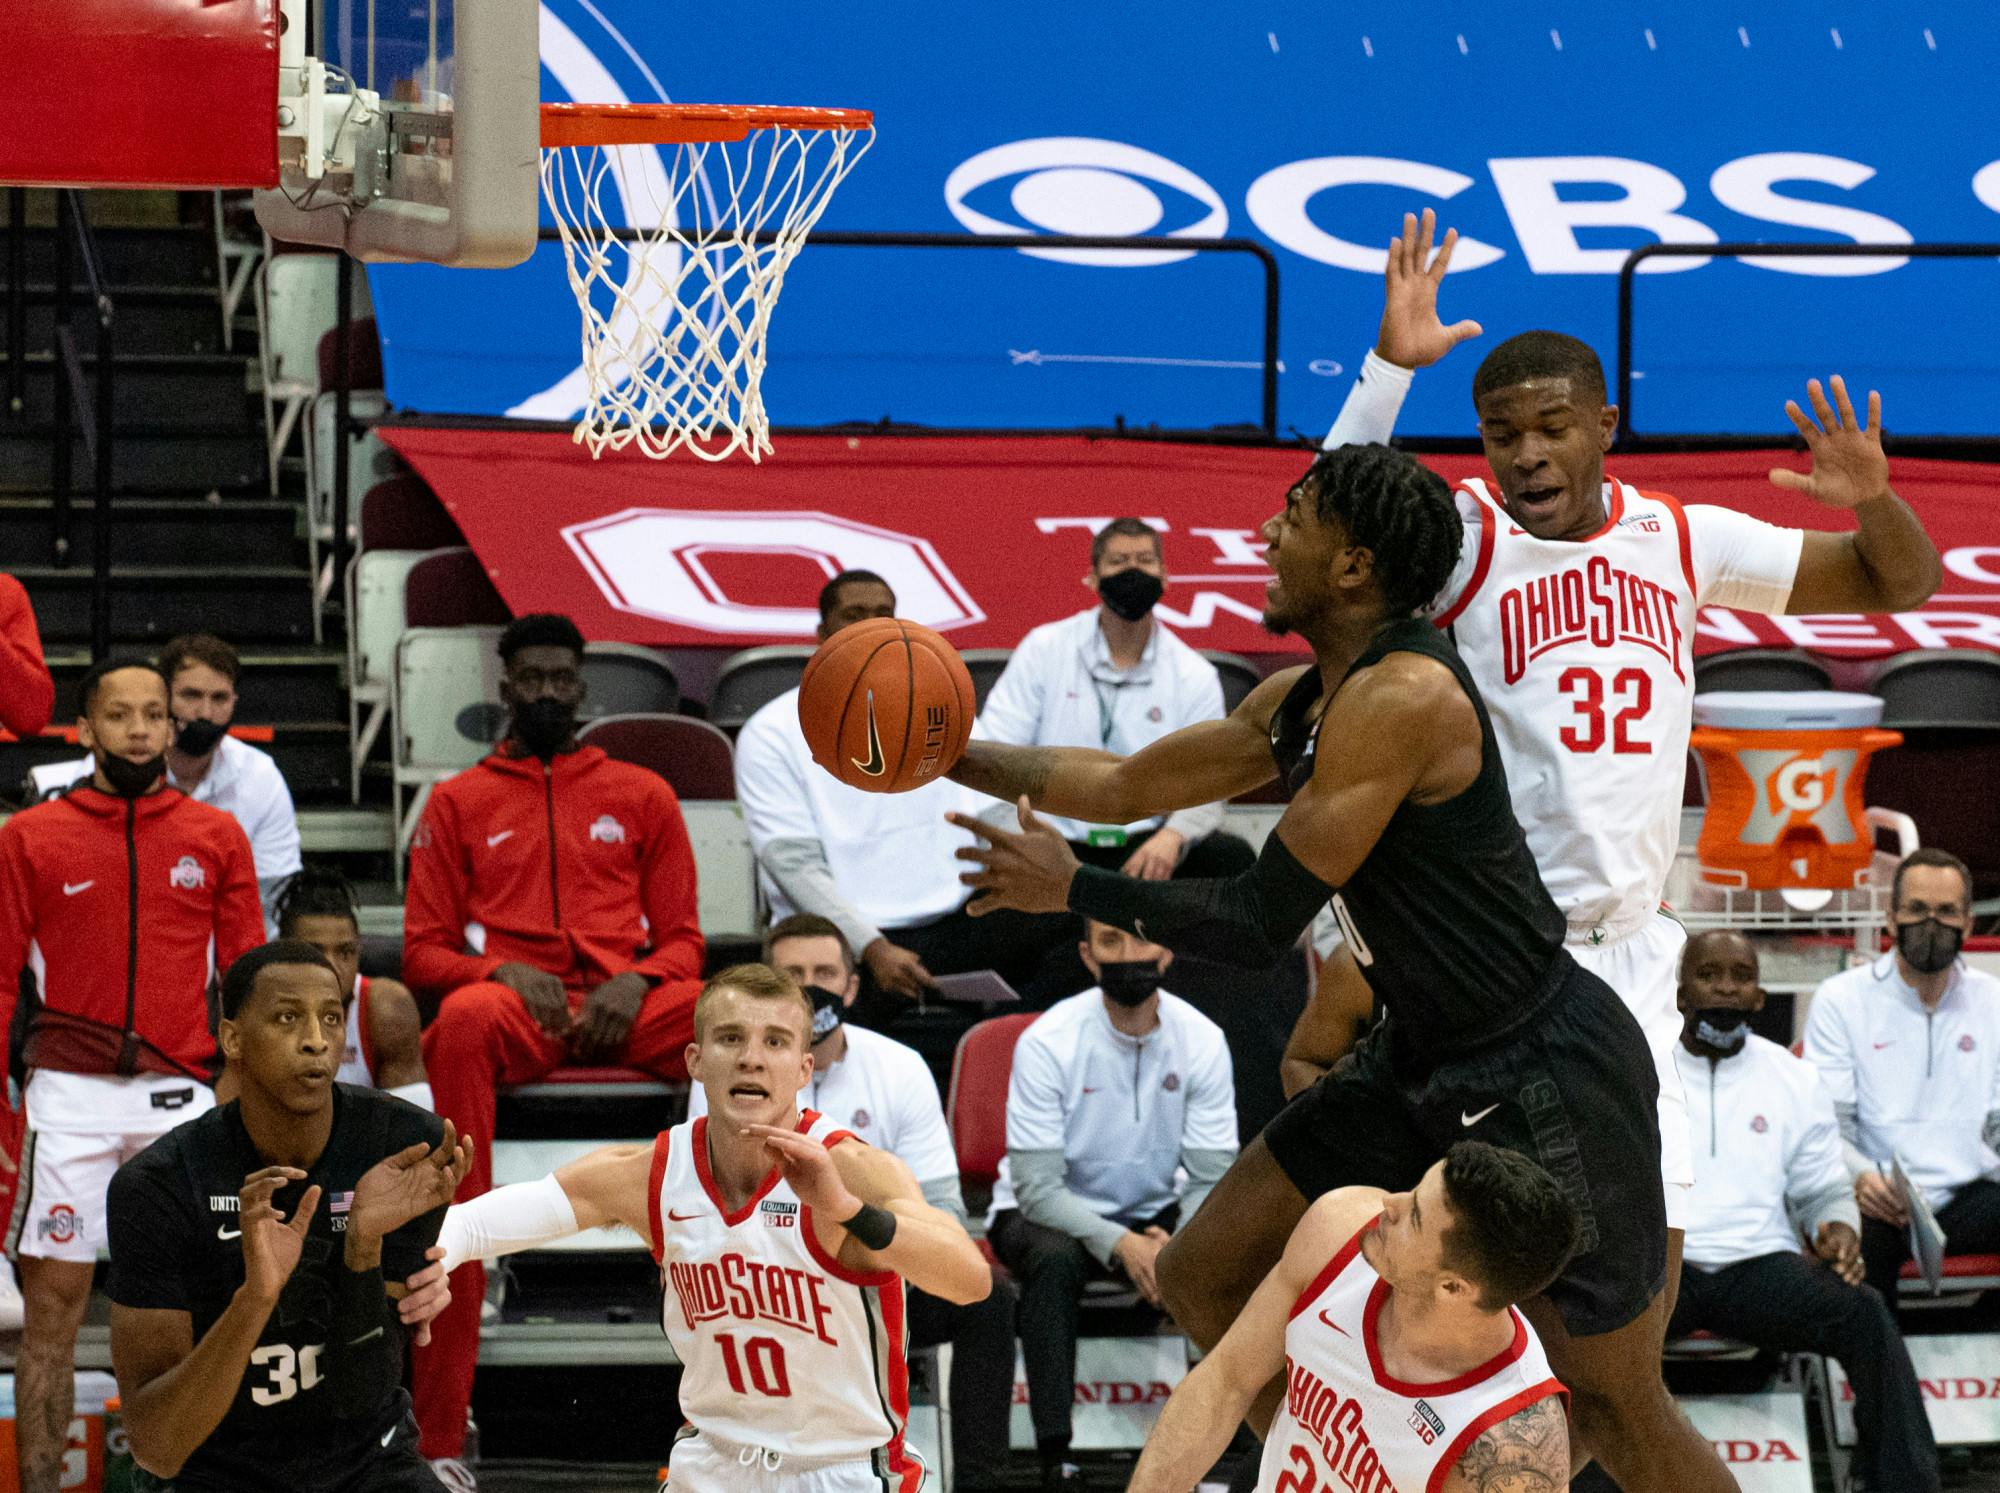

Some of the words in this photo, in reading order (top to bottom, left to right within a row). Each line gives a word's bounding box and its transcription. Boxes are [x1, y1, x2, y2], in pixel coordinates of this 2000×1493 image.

[1246, 152, 1914, 276] CBS
[1558, 667, 1653, 754] 32
[1777, 759, 1823, 811] G
[761, 1200, 798, 1214] EQUALITY
[713, 1333, 792, 1398] 10
[1415, 1398, 1446, 1437] EQUALITY
